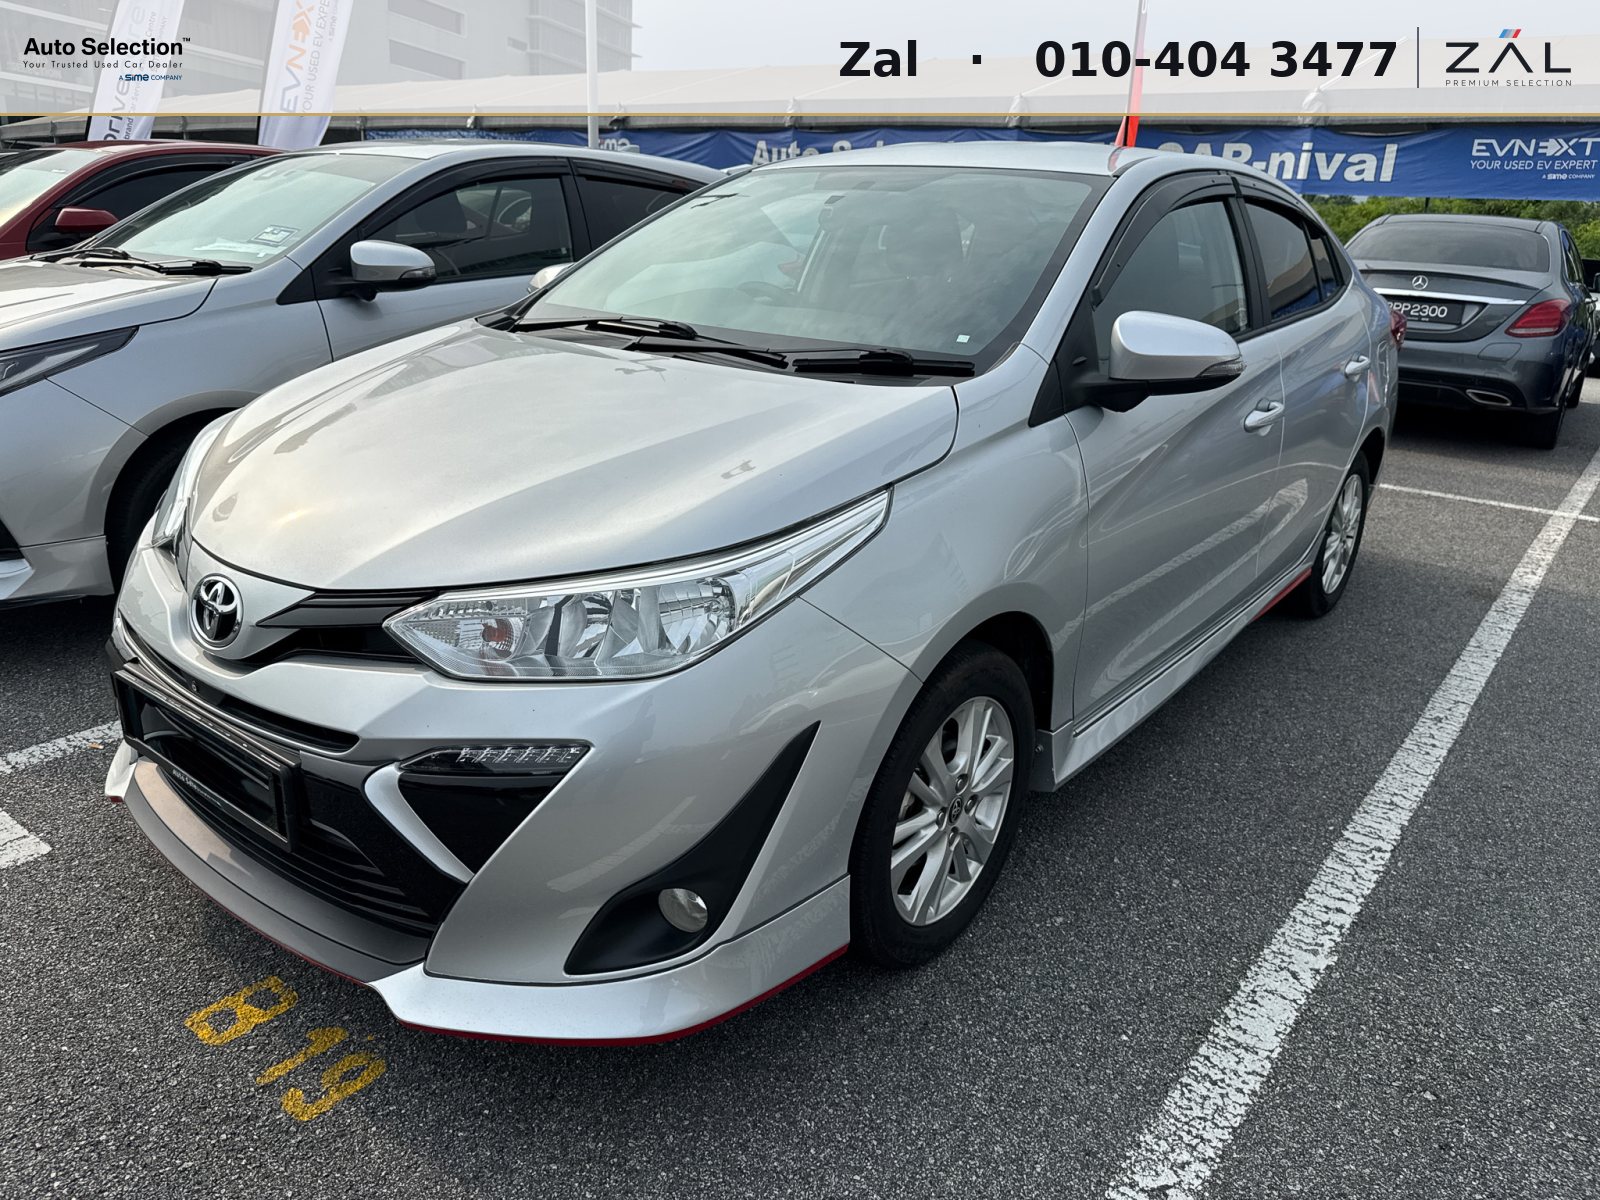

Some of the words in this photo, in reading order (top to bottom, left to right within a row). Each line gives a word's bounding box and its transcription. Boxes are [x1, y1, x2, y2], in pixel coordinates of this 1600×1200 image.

[316, 0, 331, 30] EXPE
[313, 31, 322, 48] EV
[307, 50, 320, 82] USED
[302, 84, 316, 117] OUR
[1157, 142, 1398, 183] R-nival
[1470, 160, 1501, 170] YOUR
[1503, 160, 1534, 170] USED
[1536, 160, 1552, 170] EV
[1554, 159, 1598, 170] EXPERT
